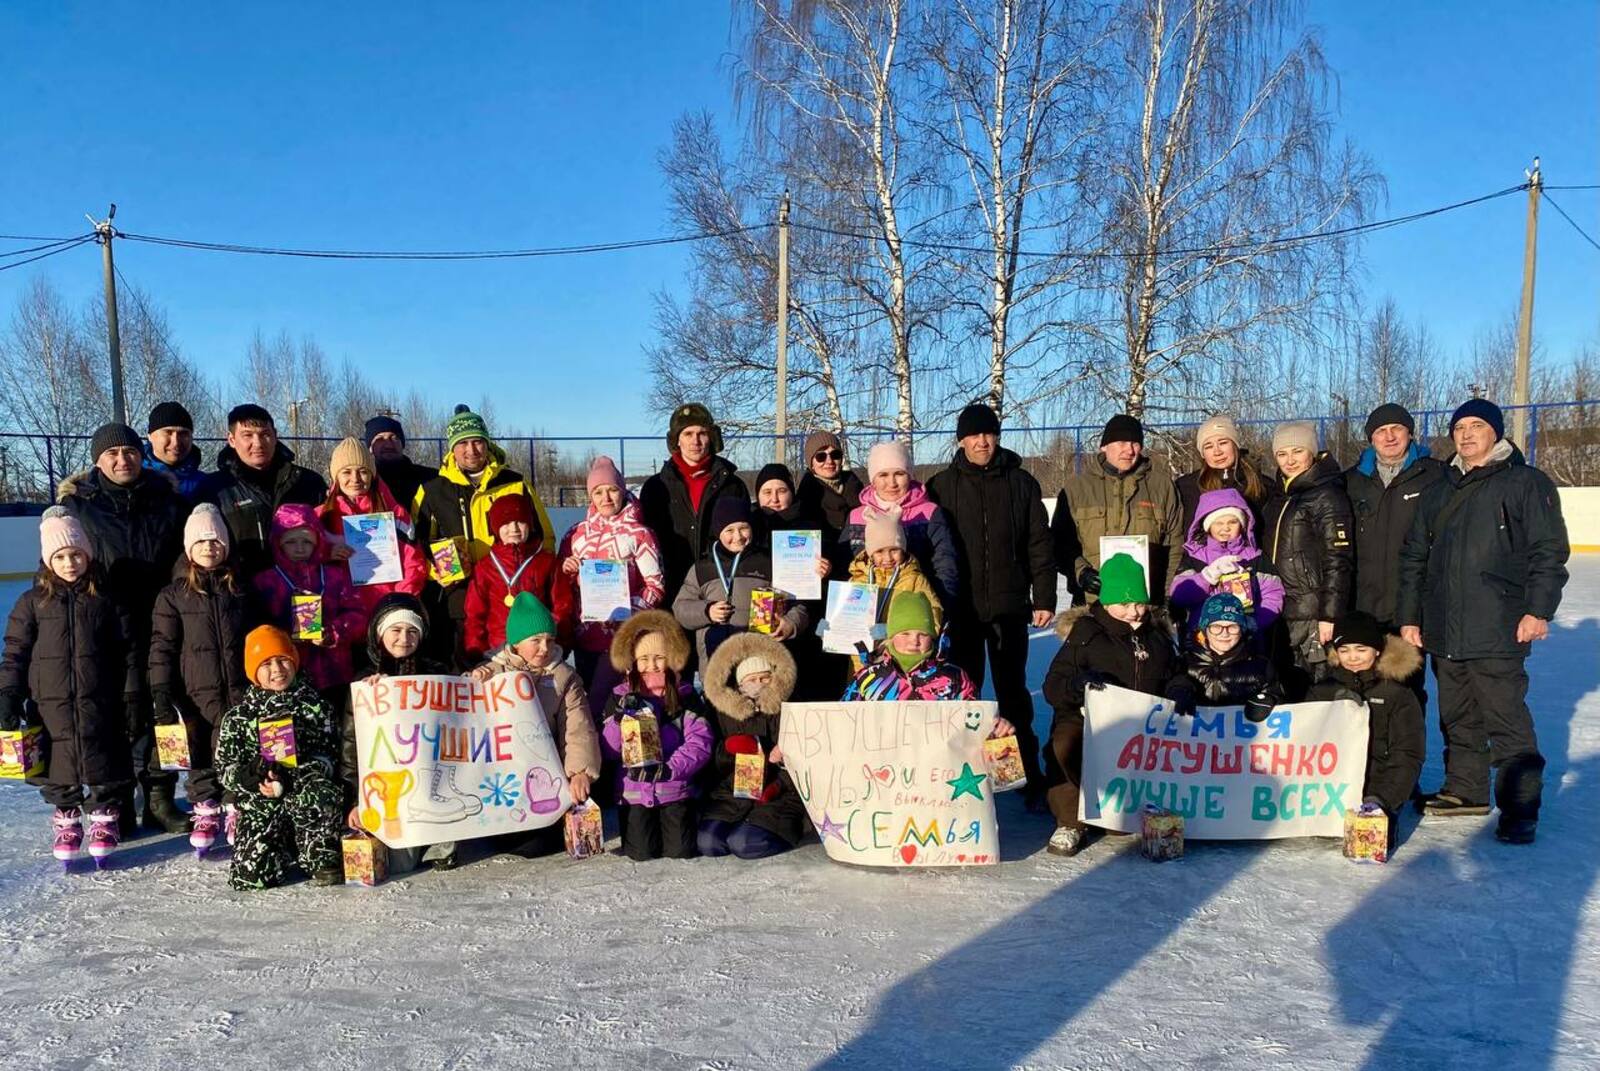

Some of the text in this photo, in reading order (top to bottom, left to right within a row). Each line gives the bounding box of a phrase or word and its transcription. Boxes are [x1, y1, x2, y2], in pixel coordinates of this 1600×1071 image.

[354, 673, 535, 718] АВТУШЕНКО
[1145, 703, 1292, 739] СЕМЬЯ
[369, 722, 513, 769] ЛУЧШИЕ
[1117, 734, 1338, 776] АВТУШЕНКО
[1097, 777, 1225, 820] ЛУЧШЕ
[1252, 783, 1349, 821] ВСЕХ
